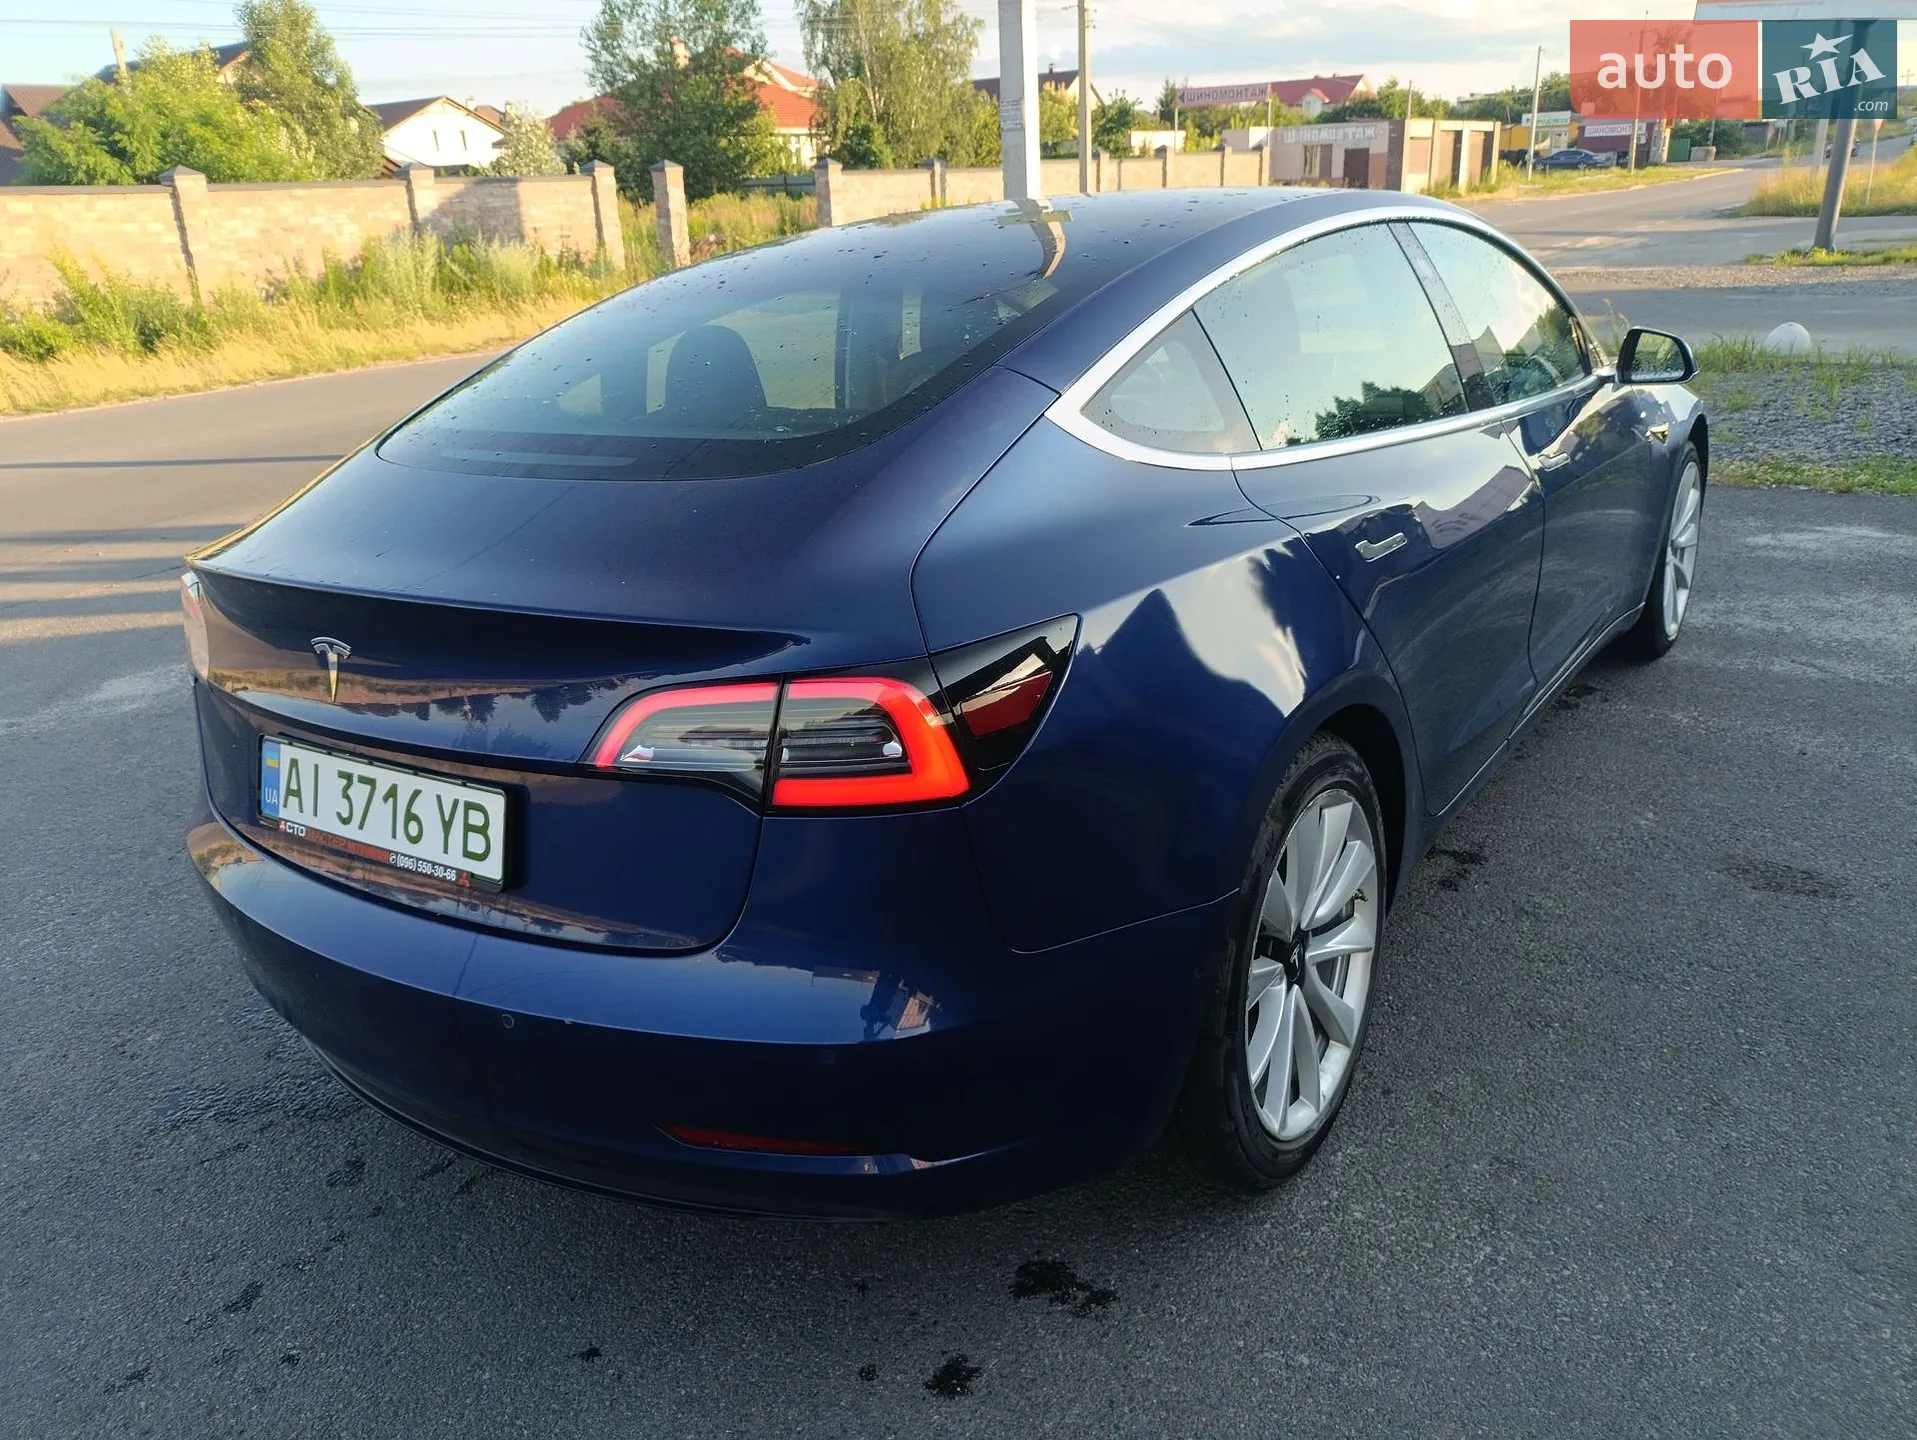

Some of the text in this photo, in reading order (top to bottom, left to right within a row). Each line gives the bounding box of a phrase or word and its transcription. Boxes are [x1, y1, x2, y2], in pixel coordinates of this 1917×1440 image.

[1186, 86, 1267, 101] ШИНОМОНТАЖ
[1586, 124, 1647, 135] ШИНОМОНТЖ
[264, 786, 278, 804] UA
[282, 758, 491, 862] AI 3716 YB
[286, 822, 306, 837] СТО
[397, 853, 416, 871] (096)
